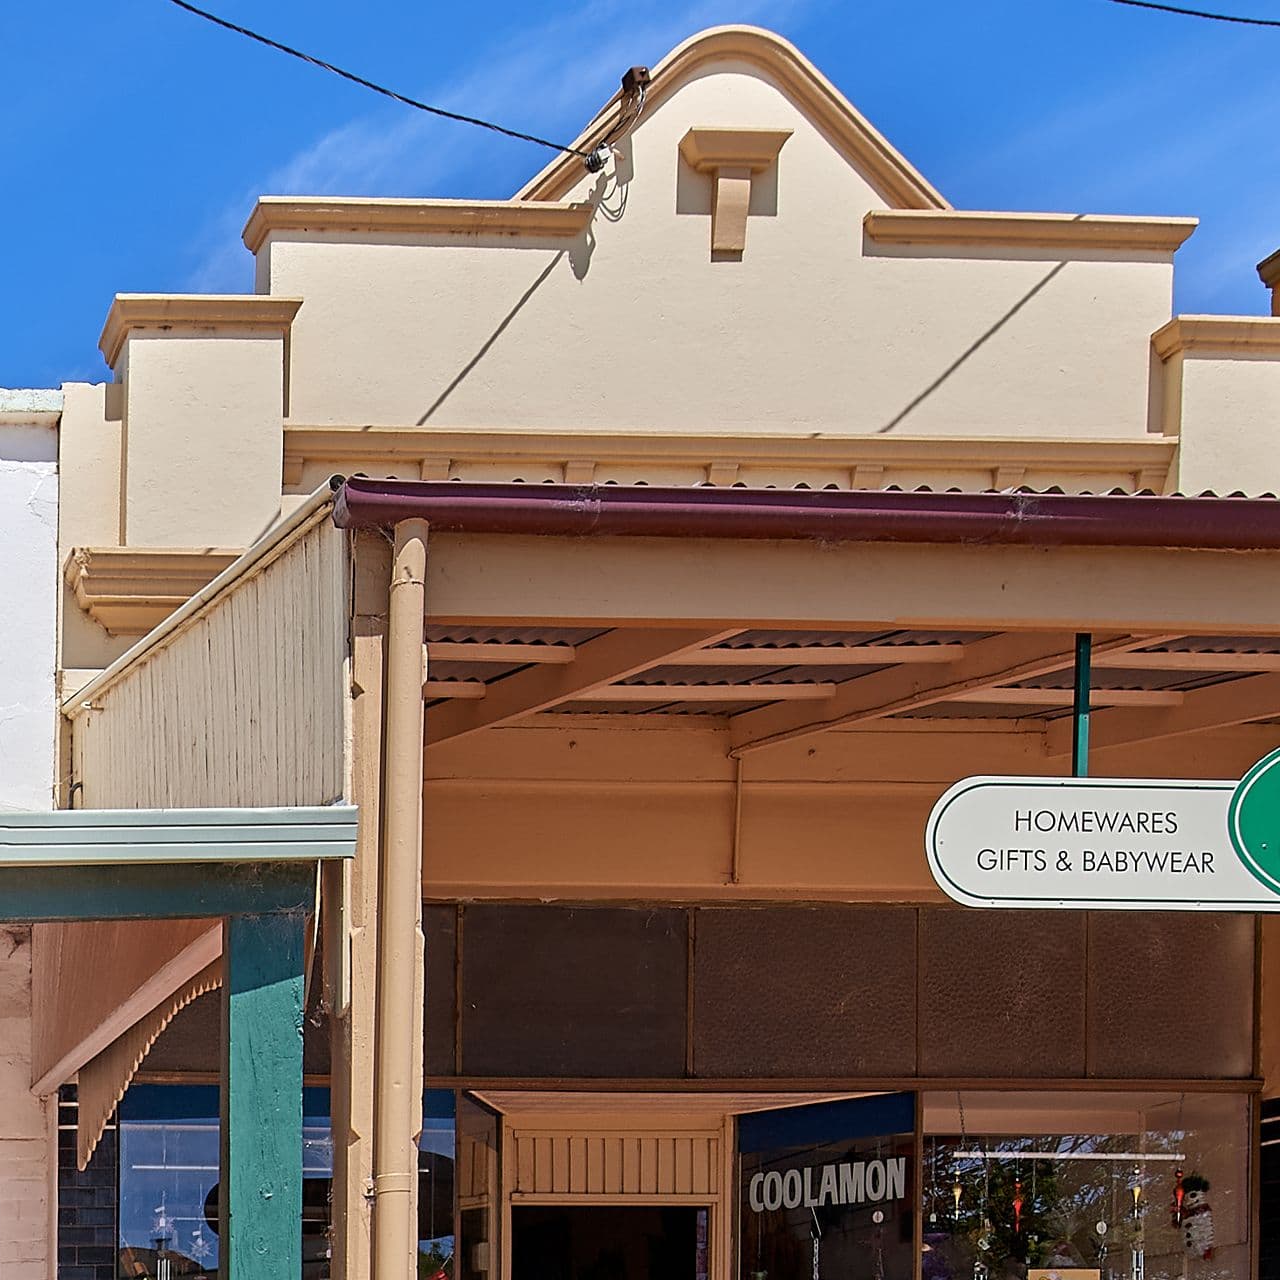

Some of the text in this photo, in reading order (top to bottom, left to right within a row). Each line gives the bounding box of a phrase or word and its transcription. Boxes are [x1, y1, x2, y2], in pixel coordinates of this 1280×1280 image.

[1014, 810, 1178, 834] HOMEWARES
[977, 848, 1215, 874] GIFTS & BABYWEAR
[749, 1157, 906, 1213] COOLAMON
